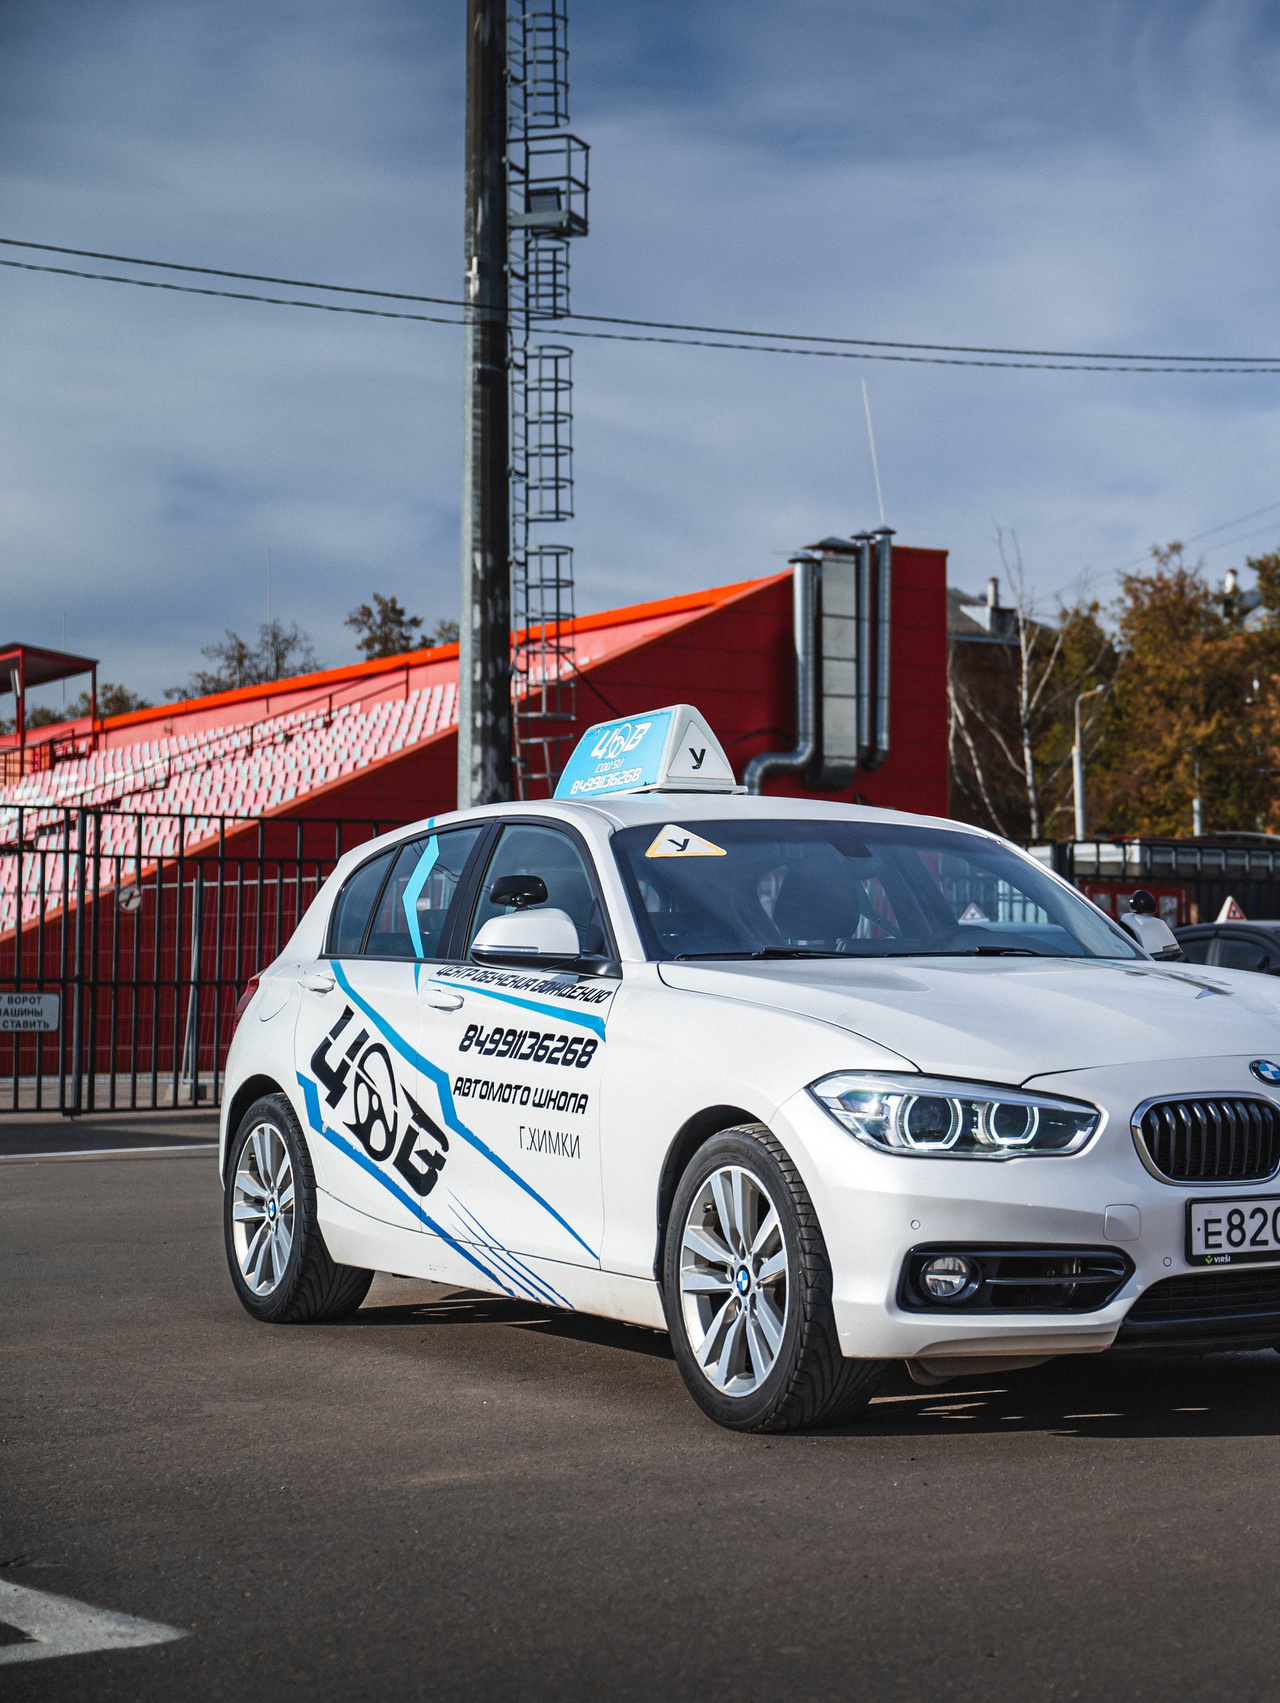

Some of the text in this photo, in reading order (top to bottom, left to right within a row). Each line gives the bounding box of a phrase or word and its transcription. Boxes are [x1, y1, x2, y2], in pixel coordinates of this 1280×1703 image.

[688, 747, 707, 770] У
[570, 767, 643, 795] 84991136268
[667, 838, 691, 852] У
[436, 964, 479, 980] ЦЕНТР
[470, 970, 540, 991] ОБУЧЕНИЯ
[7, 995, 43, 1005] ВОРОТ
[2, 1019, 50, 1030] СТАВИТЬ
[458, 1024, 599, 1069] 84991136268
[453, 1077, 589, 1115] АВТОМОТО ШКОЛА
[519, 1125, 581, 1159] Г.ХИМКИ
